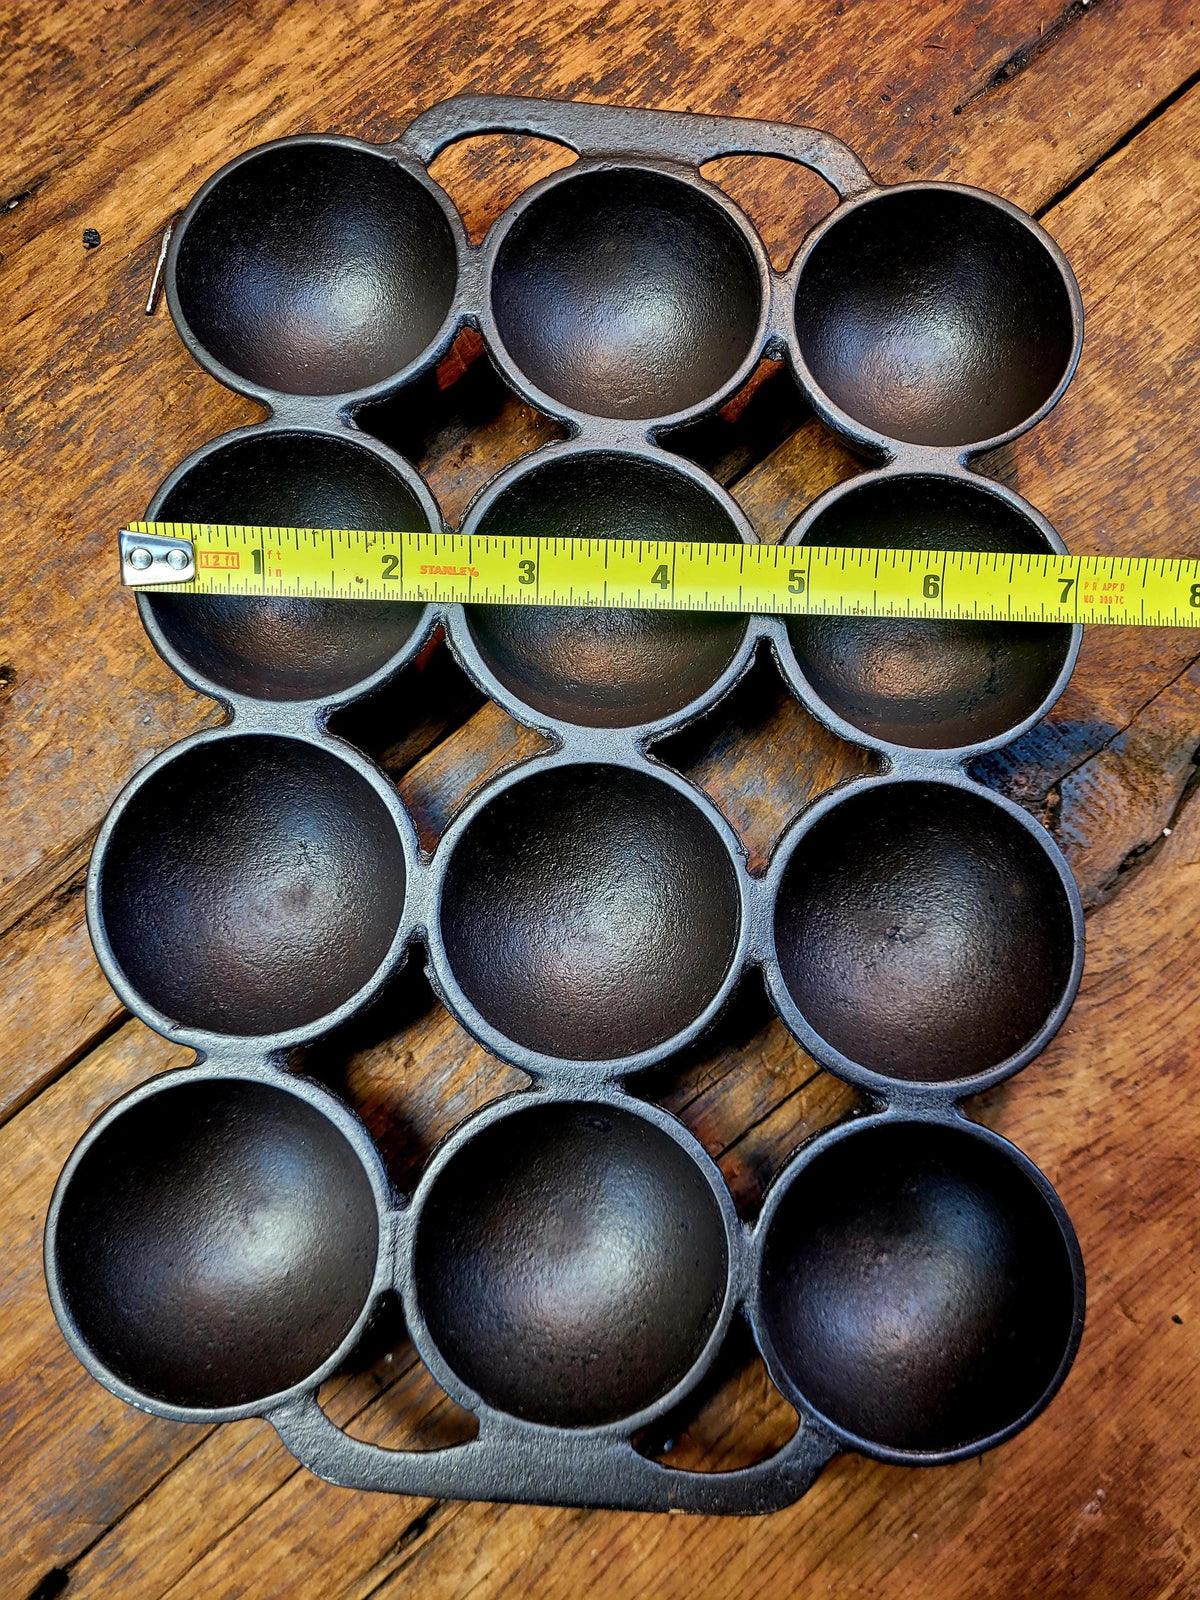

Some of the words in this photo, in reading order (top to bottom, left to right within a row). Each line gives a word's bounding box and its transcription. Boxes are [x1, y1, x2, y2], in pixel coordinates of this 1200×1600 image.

[225, 555, 236, 567] ft
[250, 549, 262, 575] 1
[381, 554, 400, 580] 2
[420, 565, 476, 576] STANLEY
[518, 559, 536, 585] 3
[650, 564, 671, 590] 4
[787, 569, 806, 594] 5
[922, 574, 940, 599] 6
[1057, 578, 1075, 603] 7
